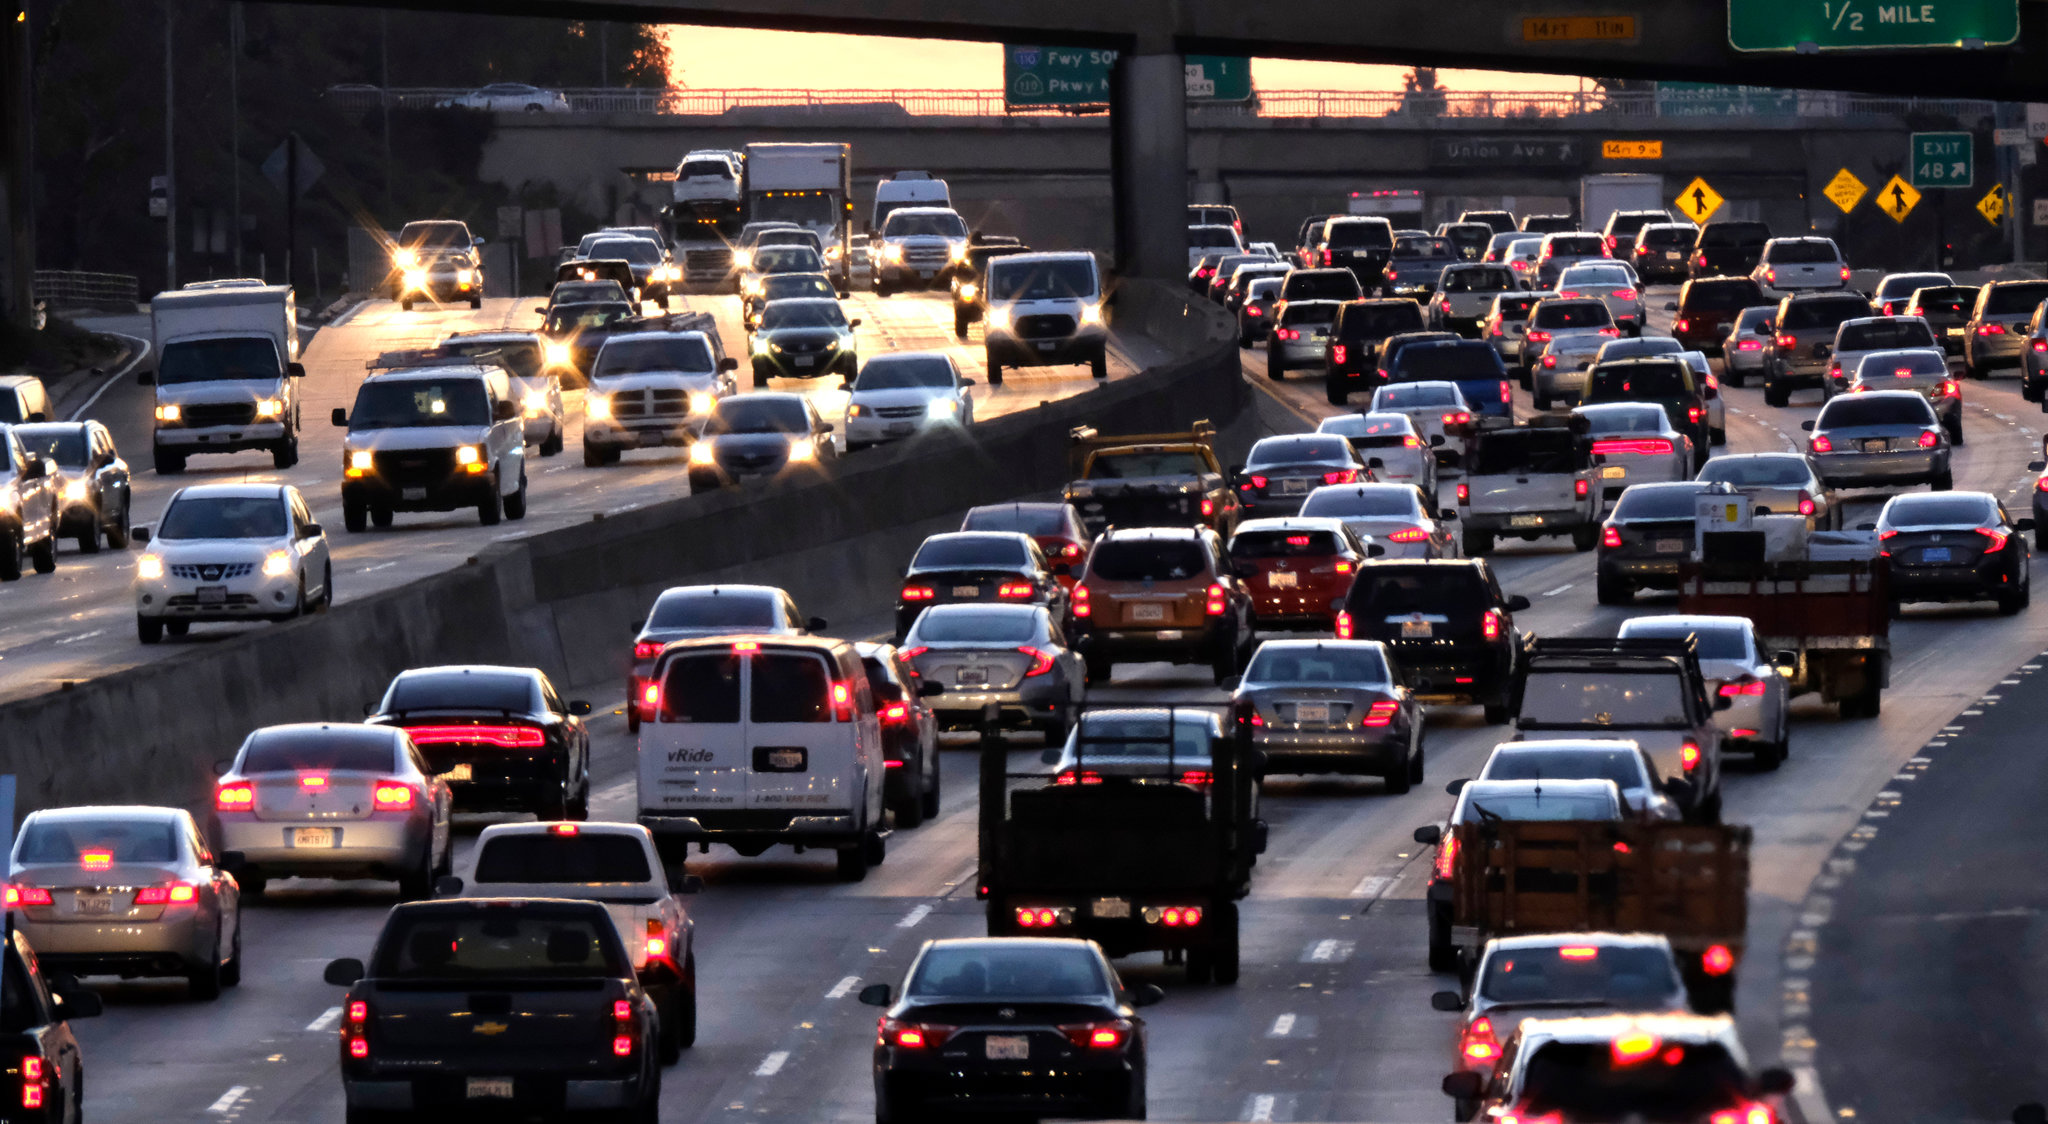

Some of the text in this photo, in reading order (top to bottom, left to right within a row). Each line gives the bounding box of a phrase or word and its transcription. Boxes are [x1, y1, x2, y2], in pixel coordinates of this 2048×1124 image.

[1878, 5, 1936, 24] MILE
[1532, 20, 1624, 37] 14 FT 11 IN
[1020, 54, 1036, 65] 110
[1048, 51, 1083, 68] Fwy
[1020, 80, 1038, 90] 110
[1048, 78, 1094, 94] Pkwy
[1447, 142, 1545, 158] Union Ave
[1607, 144, 1620, 155] 14
[1638, 144, 1646, 155] 9
[1923, 141, 1961, 156] EXIT
[667, 748, 714, 762] vRide
